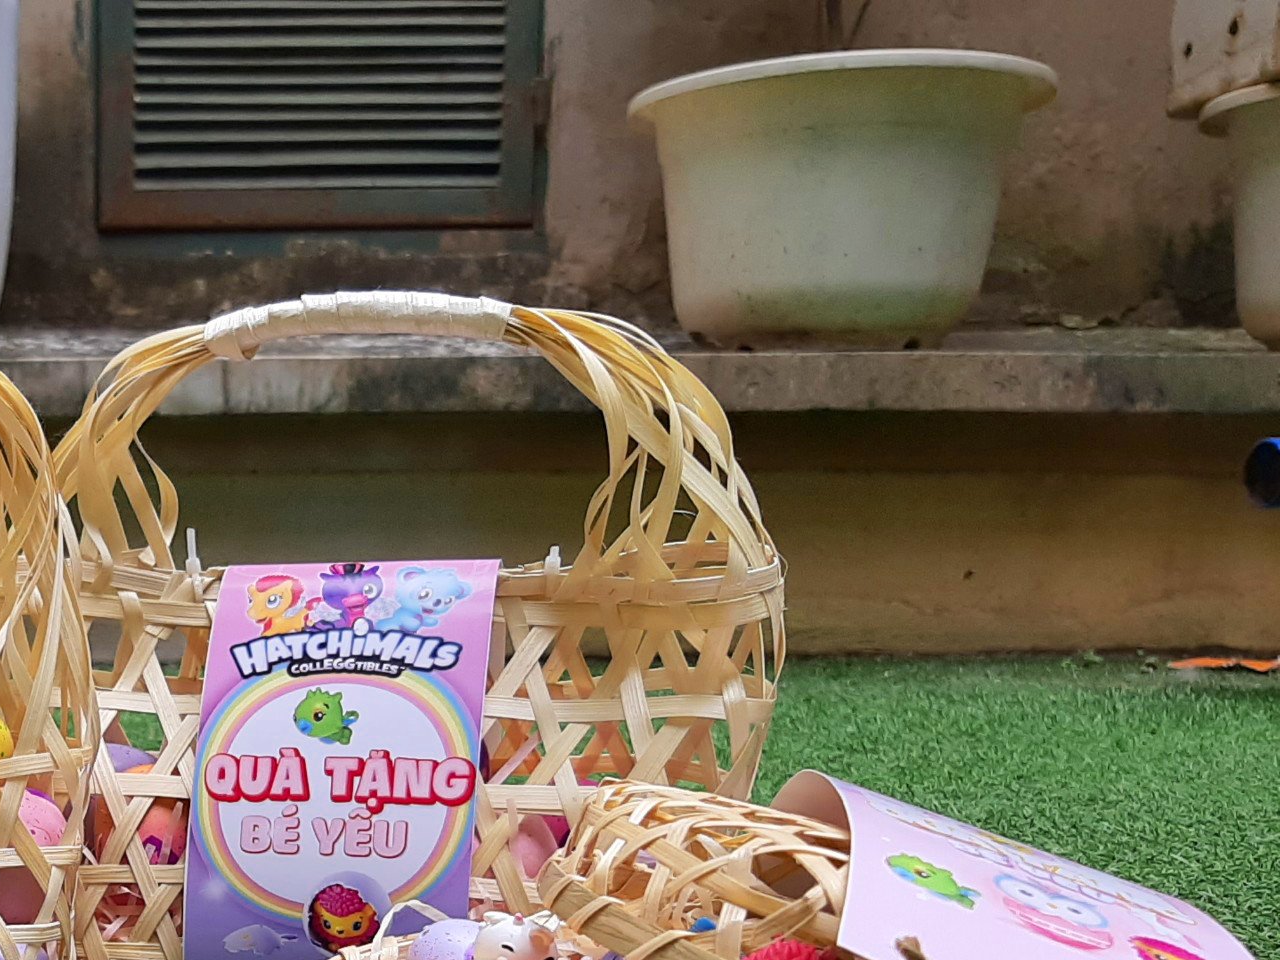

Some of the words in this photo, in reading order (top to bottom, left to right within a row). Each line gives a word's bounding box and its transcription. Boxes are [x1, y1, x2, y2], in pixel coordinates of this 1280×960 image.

[205, 748, 310, 802] QUÀ
[324, 750, 475, 814] TẶNG
[239, 804, 300, 855] BÉ
[312, 807, 408, 858] YÊU
